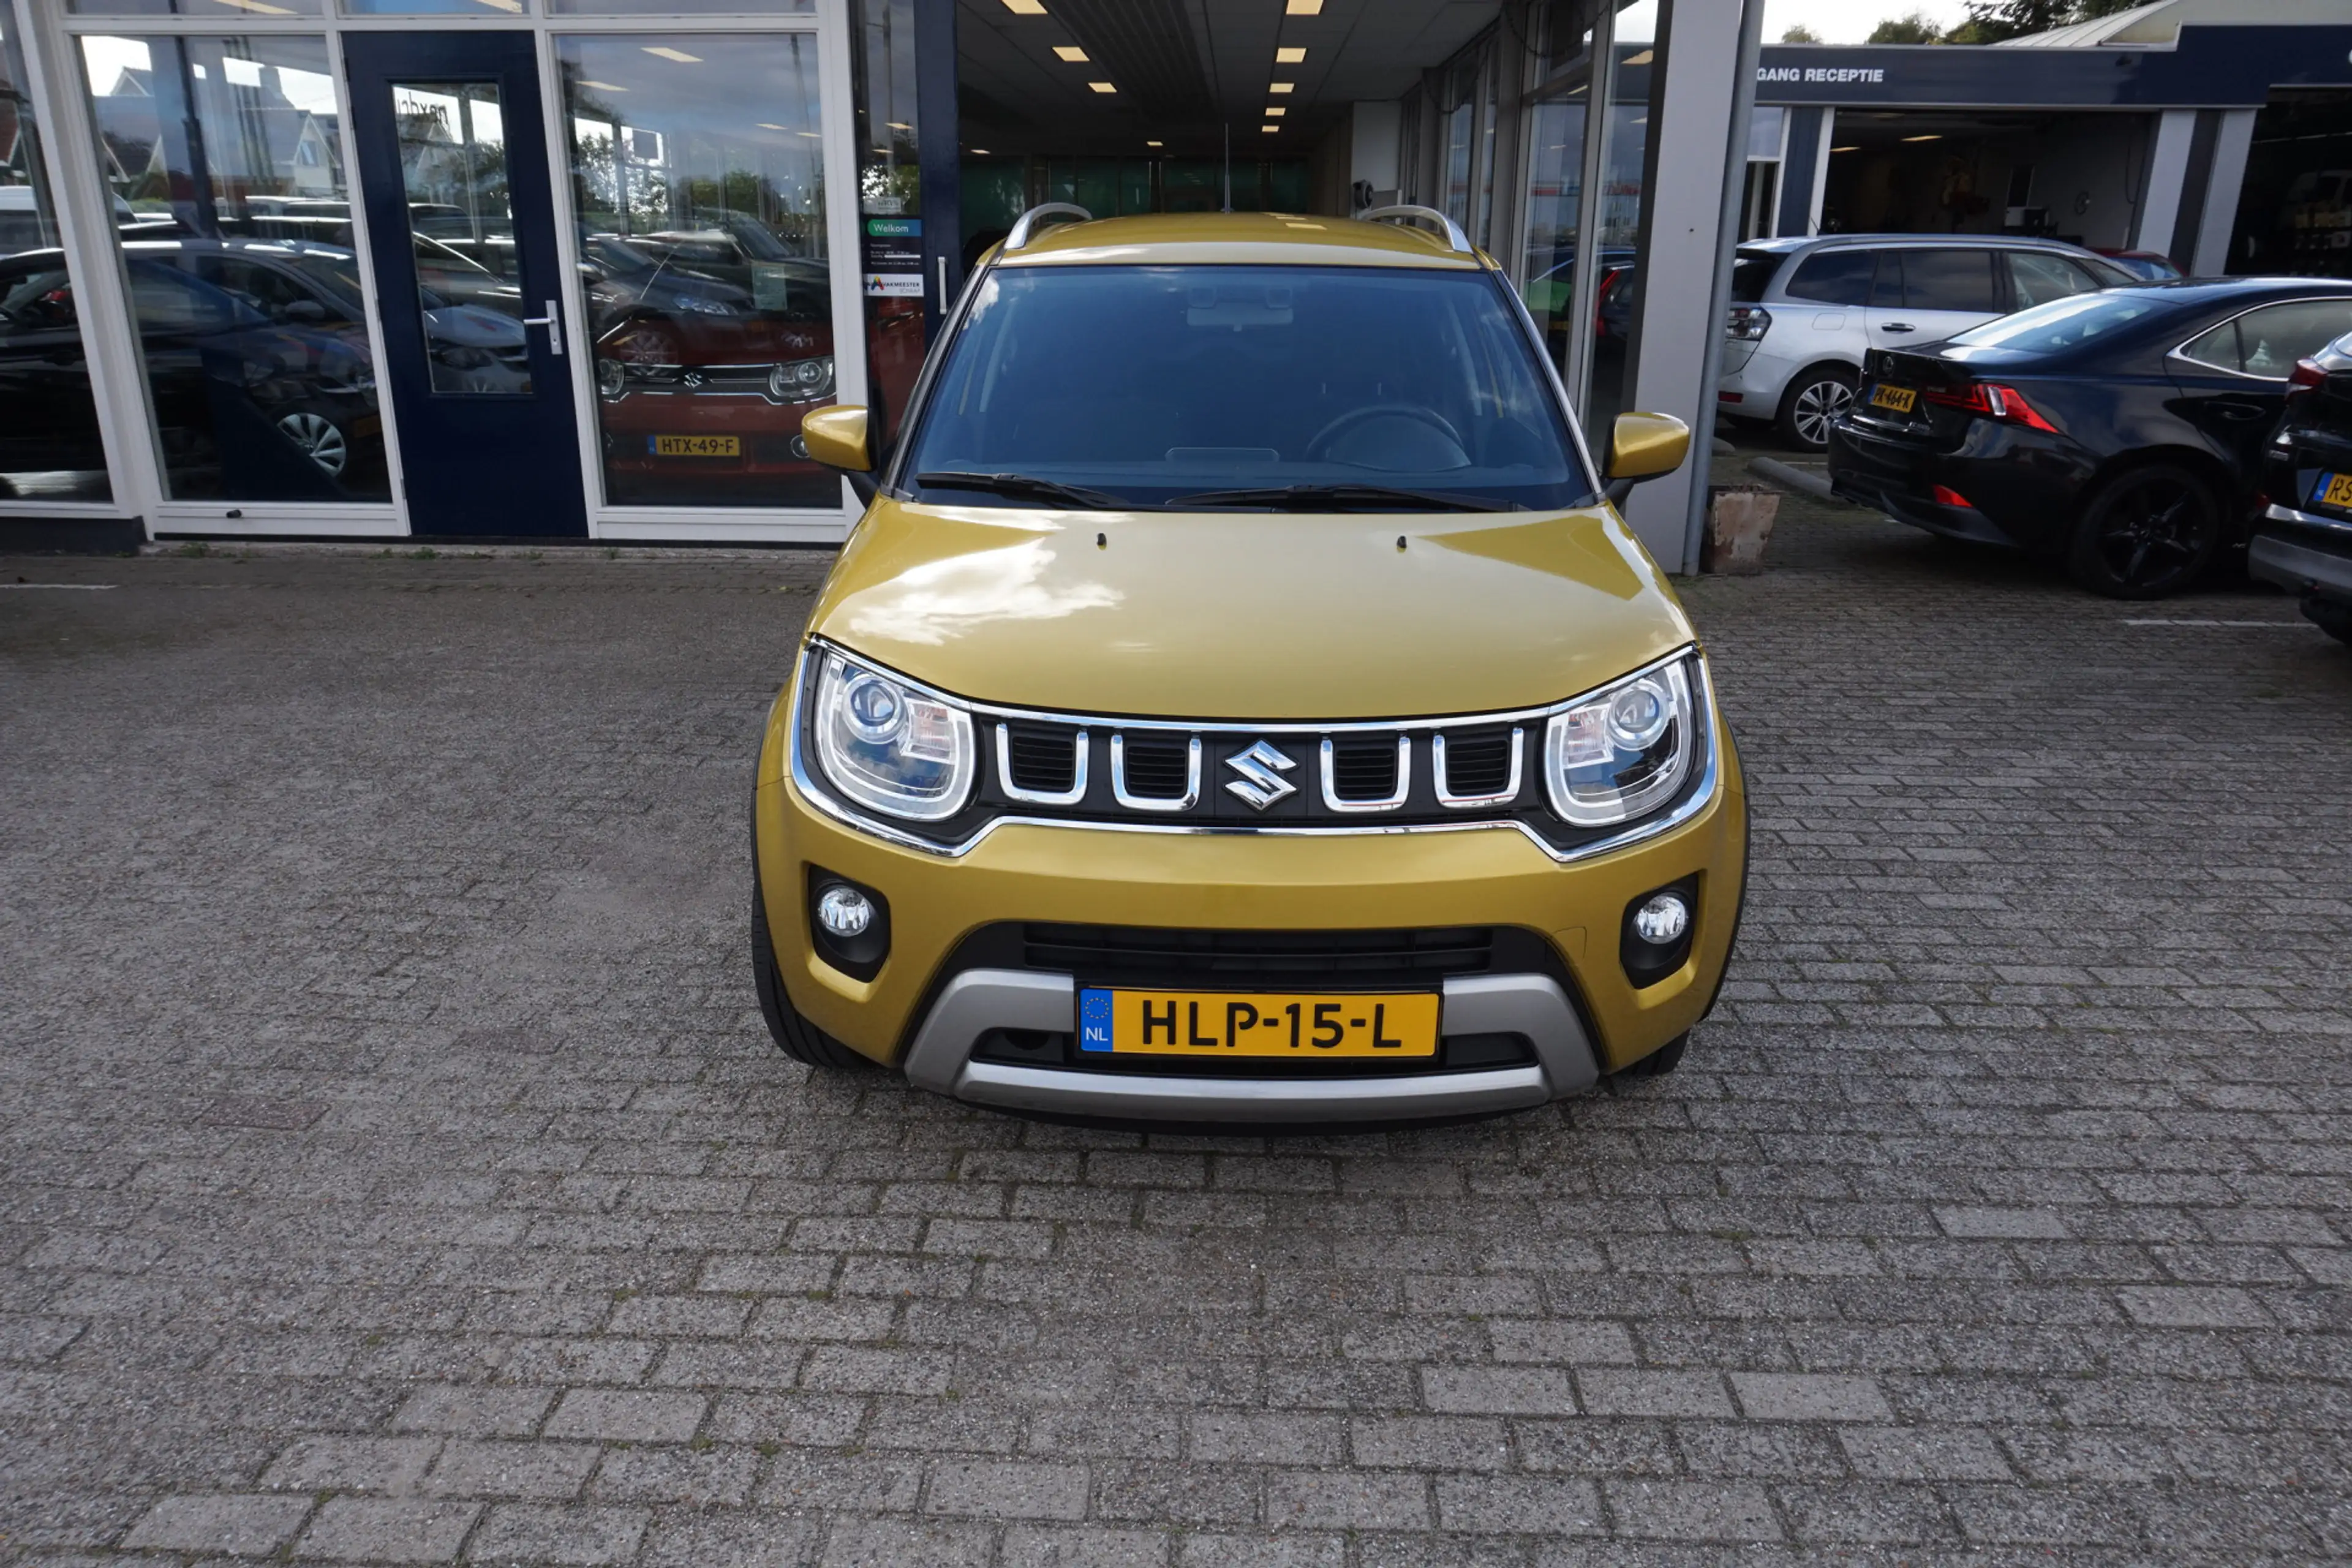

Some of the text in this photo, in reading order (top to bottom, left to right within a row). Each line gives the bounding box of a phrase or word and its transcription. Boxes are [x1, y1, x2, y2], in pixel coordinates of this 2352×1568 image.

[1804, 68, 1884, 82] RECEPTIE
[873, 224, 910, 233] Welkom
[662, 438, 734, 454] HTX-49-F
[1085, 1000, 1402, 1049] NL HLP-15-L
